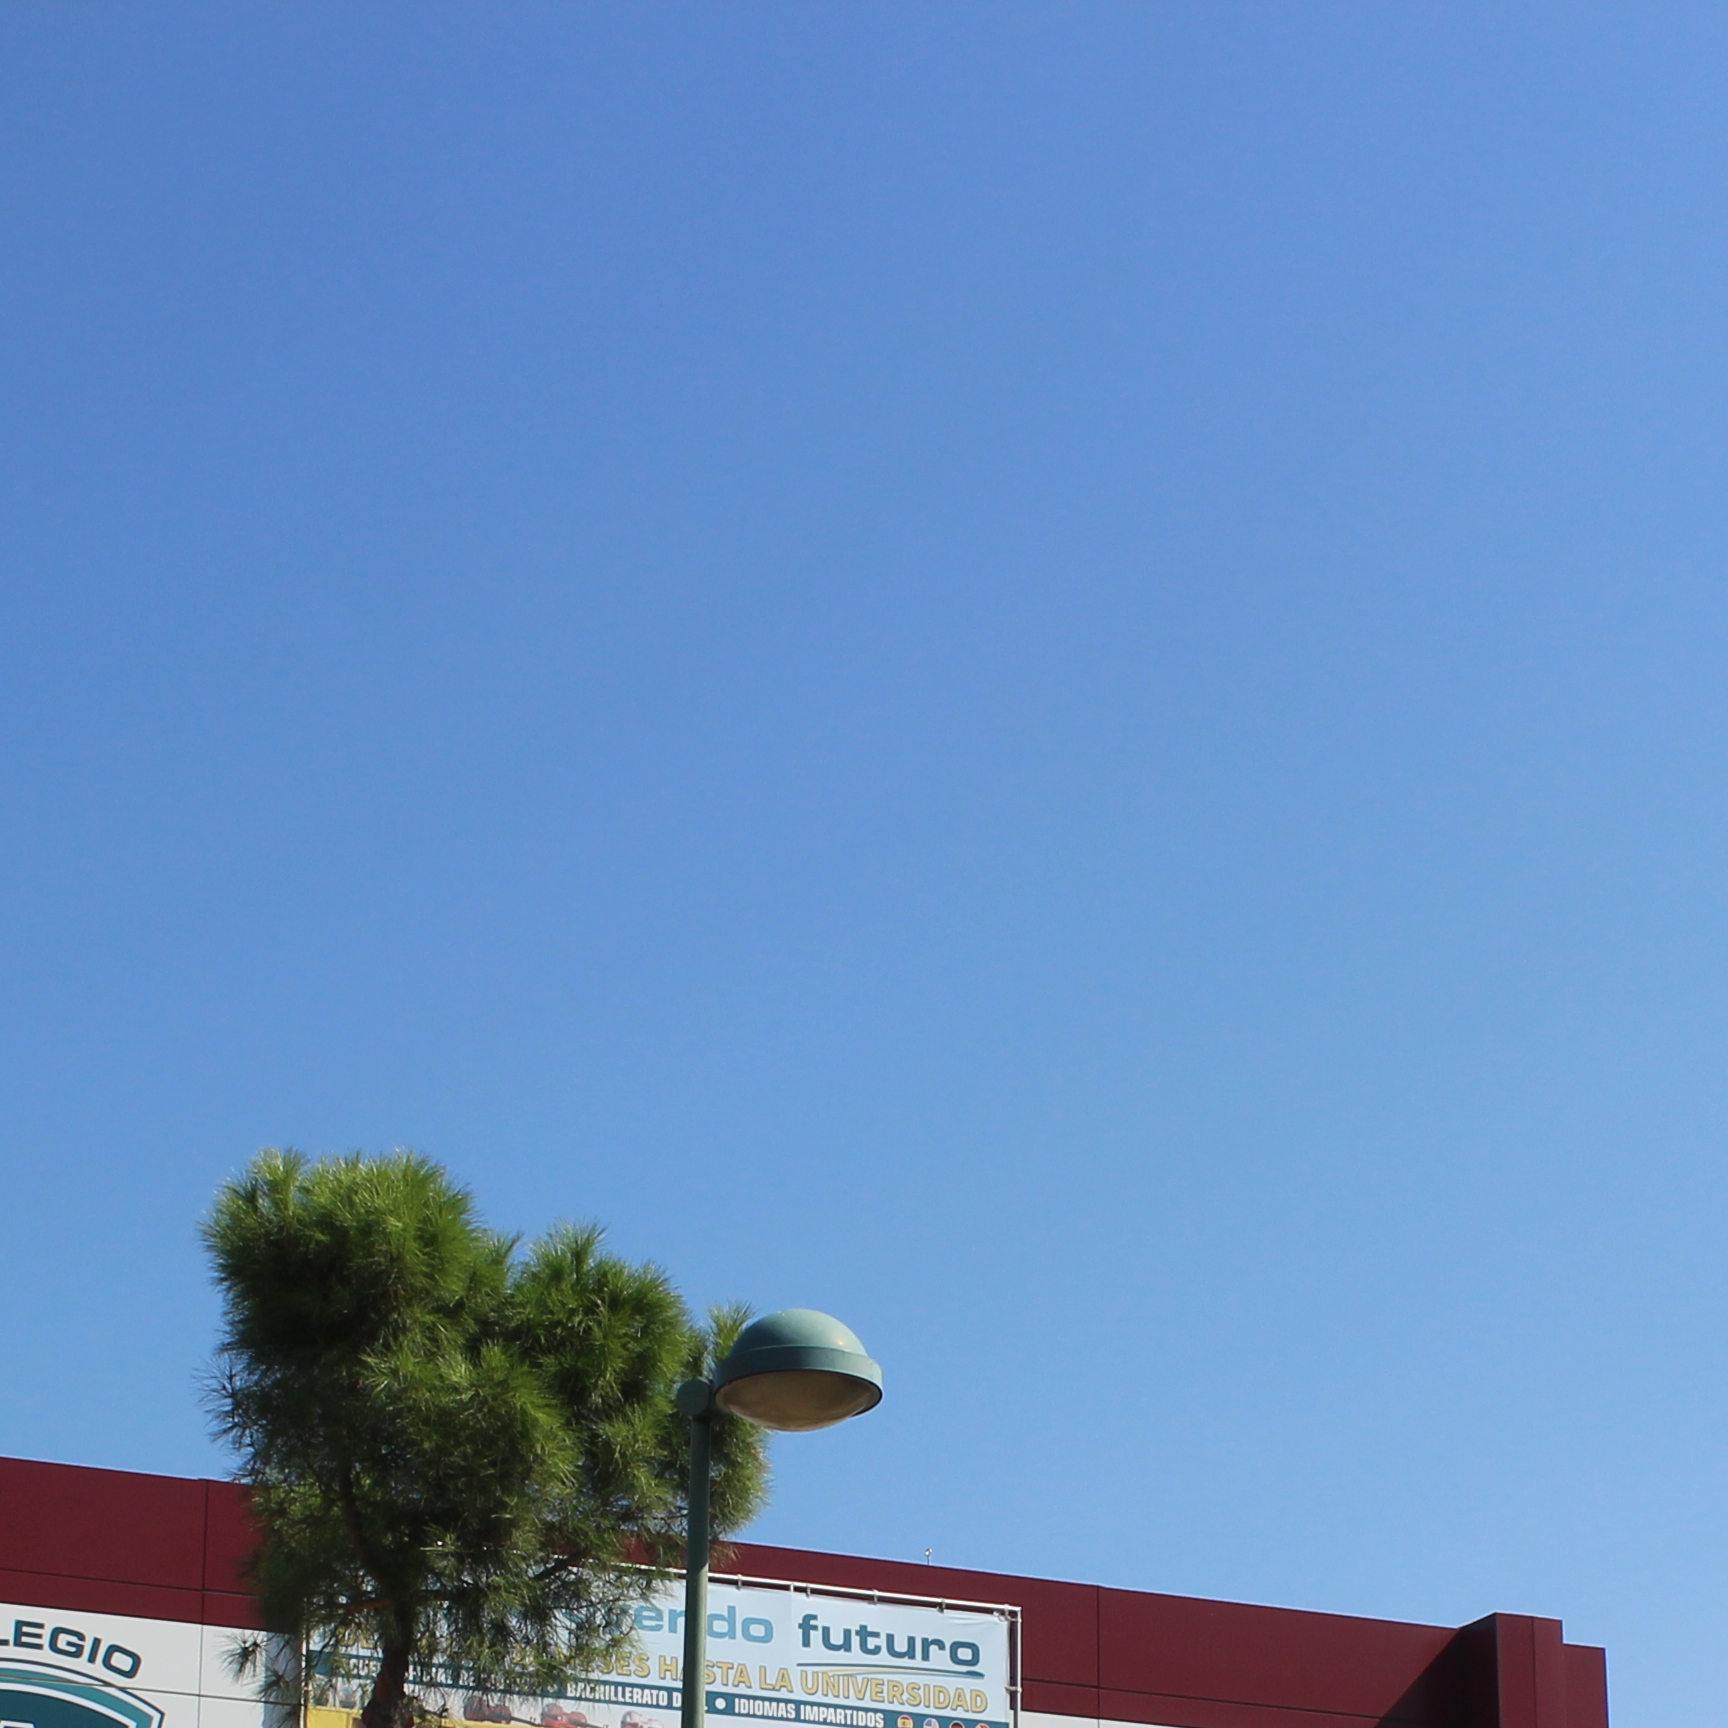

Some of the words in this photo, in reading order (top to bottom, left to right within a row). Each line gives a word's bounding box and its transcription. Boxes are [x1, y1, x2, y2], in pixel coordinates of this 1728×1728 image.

[798, 1613, 981, 1667] futuro
[566, 1682, 668, 1707] BACHILLERATO
[658, 1654, 752, 1688] HSTA
[759, 1667, 793, 1692] LA
[800, 1670, 988, 1713] UNIVERSIDAD
[734, 1697, 796, 1719] IDIOMAS
[800, 1704, 885, 1728] IMPARTIDOS
